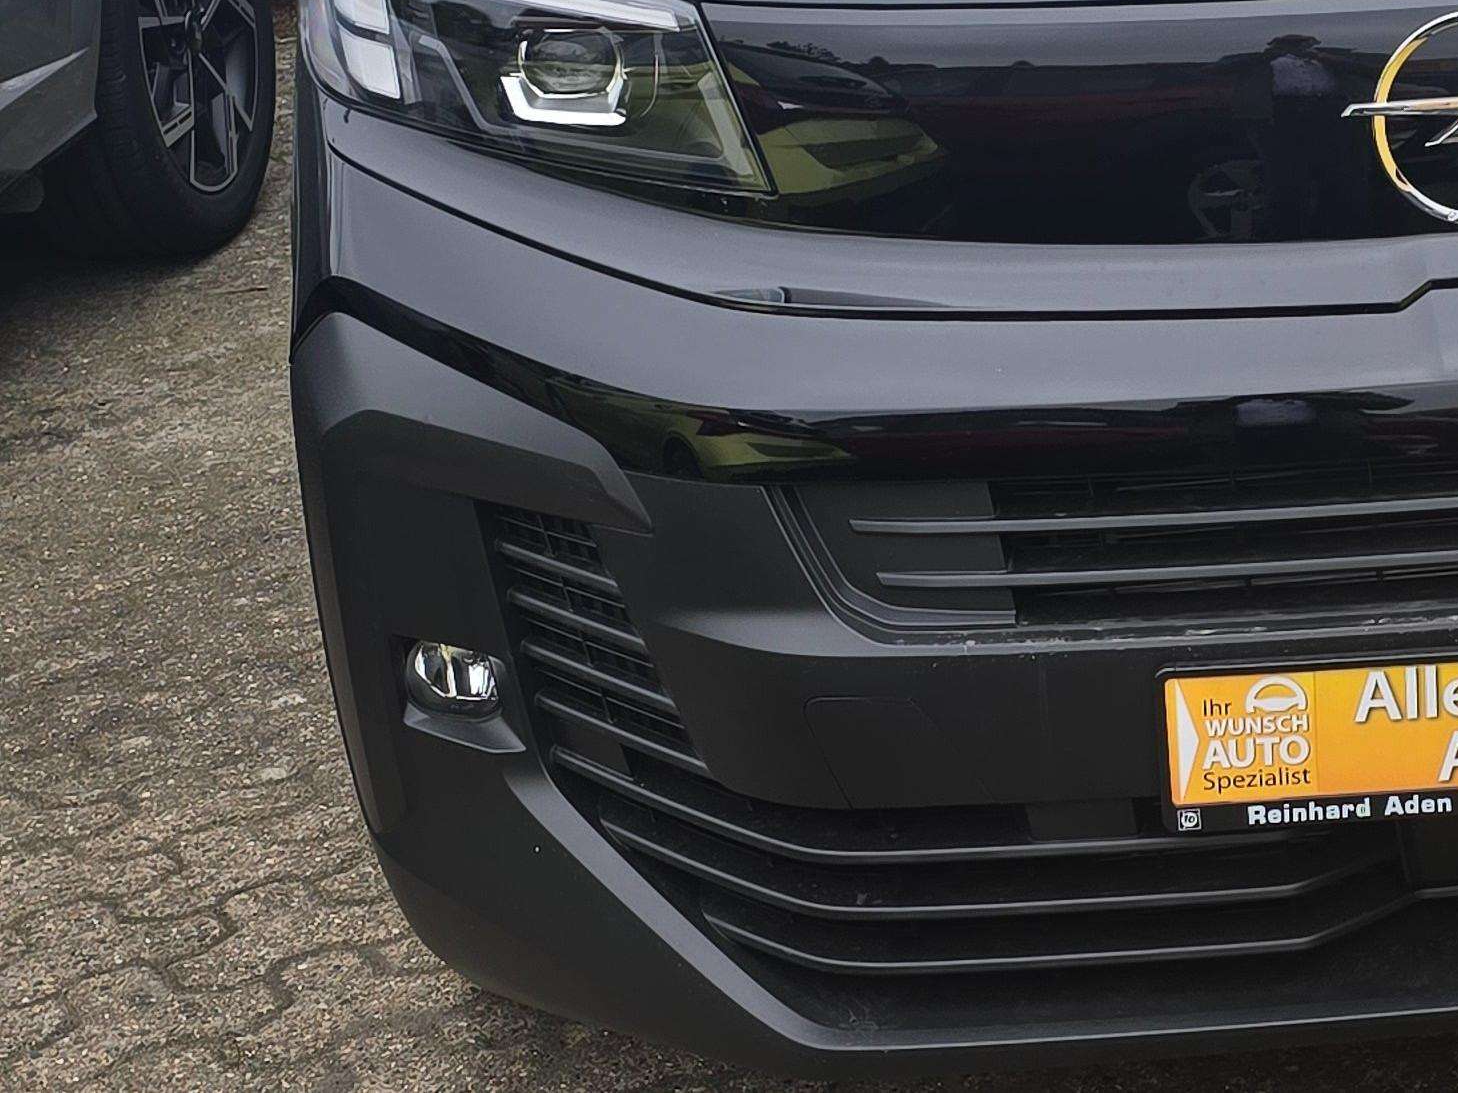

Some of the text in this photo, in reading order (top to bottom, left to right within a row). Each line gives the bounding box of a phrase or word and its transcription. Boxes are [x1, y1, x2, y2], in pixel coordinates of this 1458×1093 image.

[1203, 699, 1232, 717] Ihr
[1205, 713, 1309, 737] WUNSCH
[1202, 735, 1311, 770] AUTO
[1203, 767, 1311, 794] Spezialist
[1247, 797, 1371, 825] Reinhard
[1384, 794, 1452, 816] Aden
